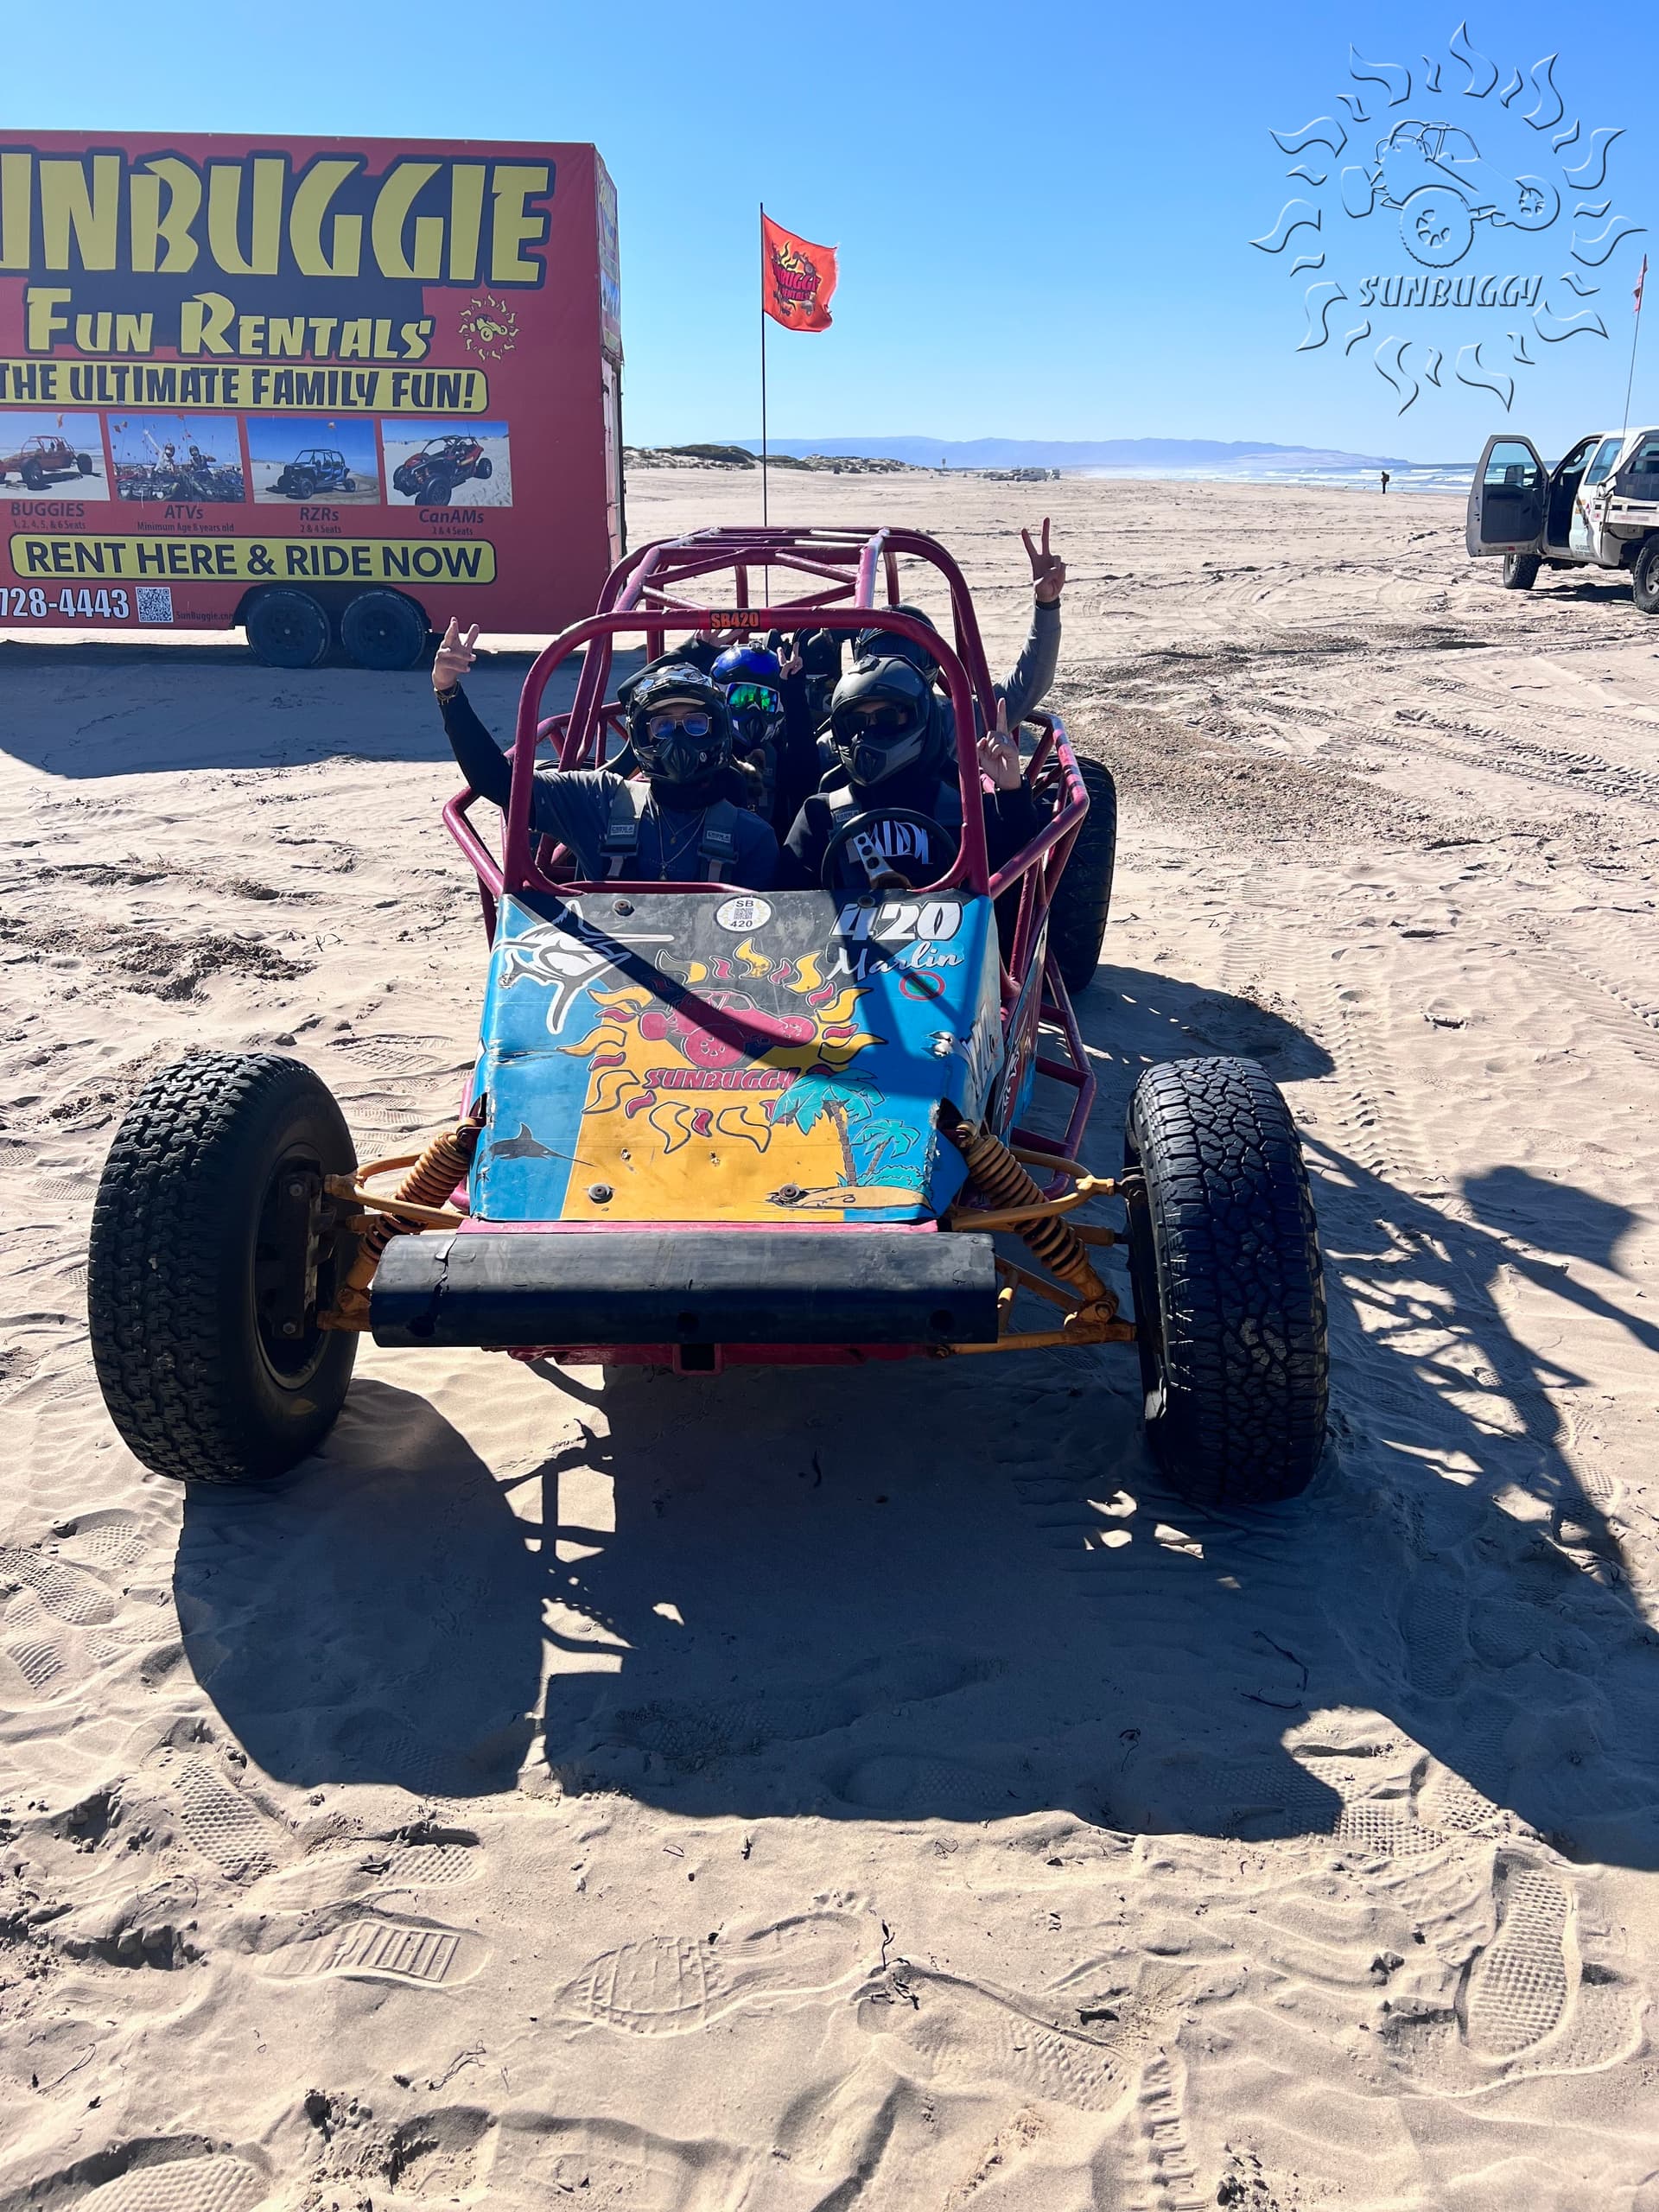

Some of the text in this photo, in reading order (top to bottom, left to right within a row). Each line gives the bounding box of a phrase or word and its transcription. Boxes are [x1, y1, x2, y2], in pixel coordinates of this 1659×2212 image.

[70, 364, 240, 404] ULTIMATE
[252, 369, 380, 407] FAMILY
[391, 372, 476, 409] FUN!
[11, 502, 85, 517] BUGGIES
[164, 505, 203, 519] ATVs
[300, 506, 339, 521] RZRs
[419, 509, 484, 524] CanAMs
[64, 520, 86, 530] Seats
[137, 521, 175, 531] Minimum
[177, 523, 192, 533] Age
[199, 524, 220, 533] years
[221, 523, 234, 532] old
[321, 524, 341, 534] Seats
[452, 526, 474, 536] Seats
[25, 541, 483, 579] RENT HERE & RIDE NOW
[710, 612, 760, 628] SB420
[729, 919, 753, 928] 420
[830, 901, 963, 941] 420
[827, 940, 964, 982] Marlin
[642, 1068, 799, 1090] SUNBUGGY
